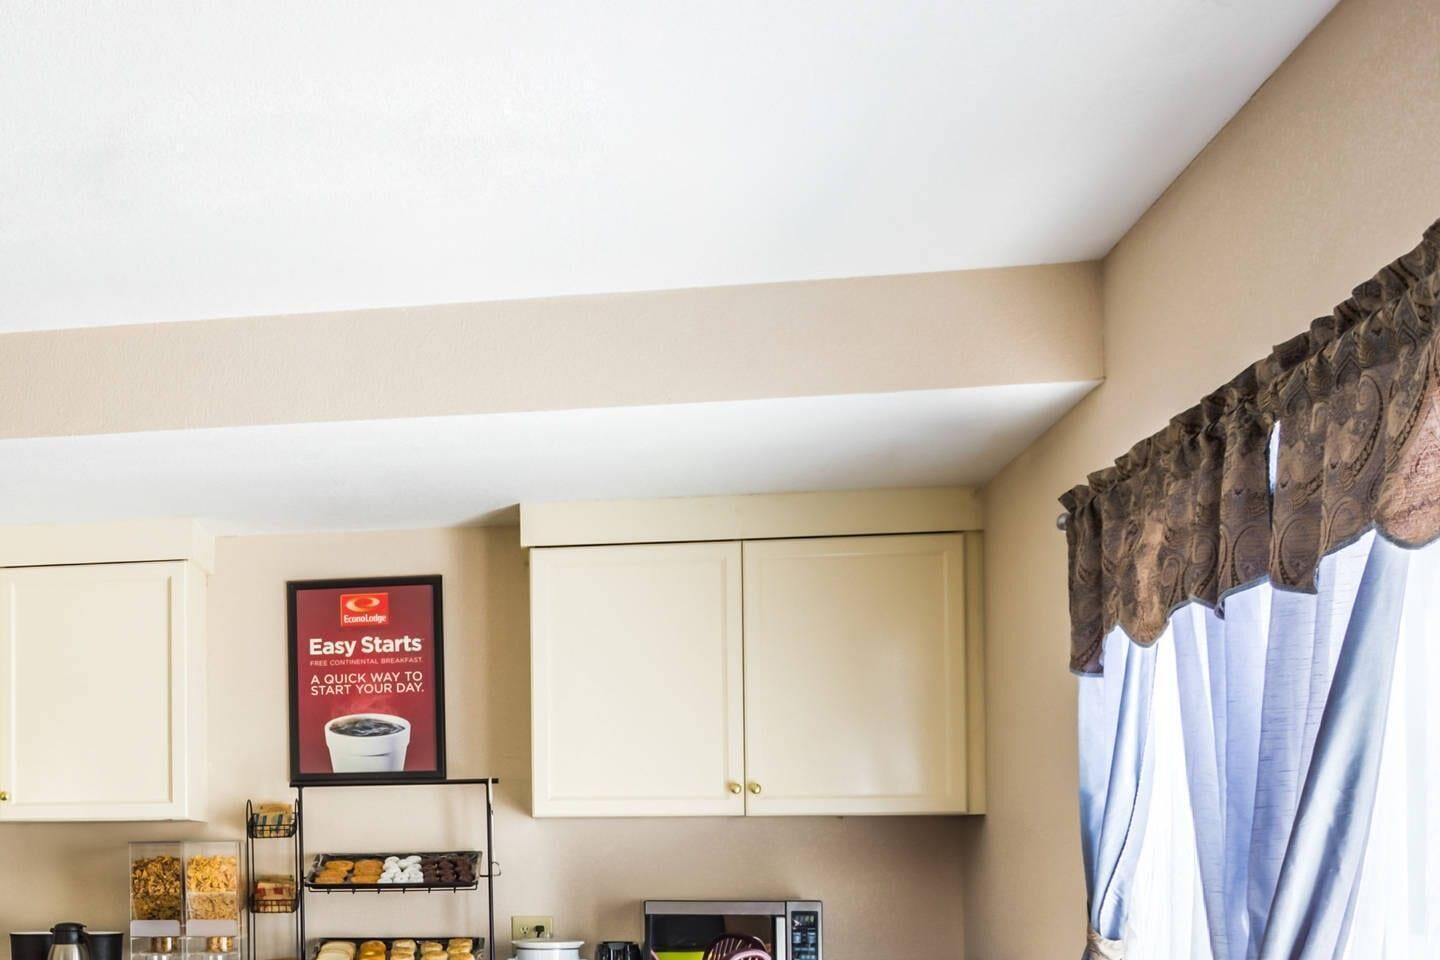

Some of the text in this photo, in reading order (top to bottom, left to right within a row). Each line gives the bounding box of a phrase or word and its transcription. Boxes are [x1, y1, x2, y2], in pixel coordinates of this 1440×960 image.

[309, 635, 422, 657] Easy Starts
[329, 658, 379, 666] CONTINENTAL
[311, 671, 423, 685] A QUICK WAY TO
[310, 682, 425, 696] START YOUR DAY.
